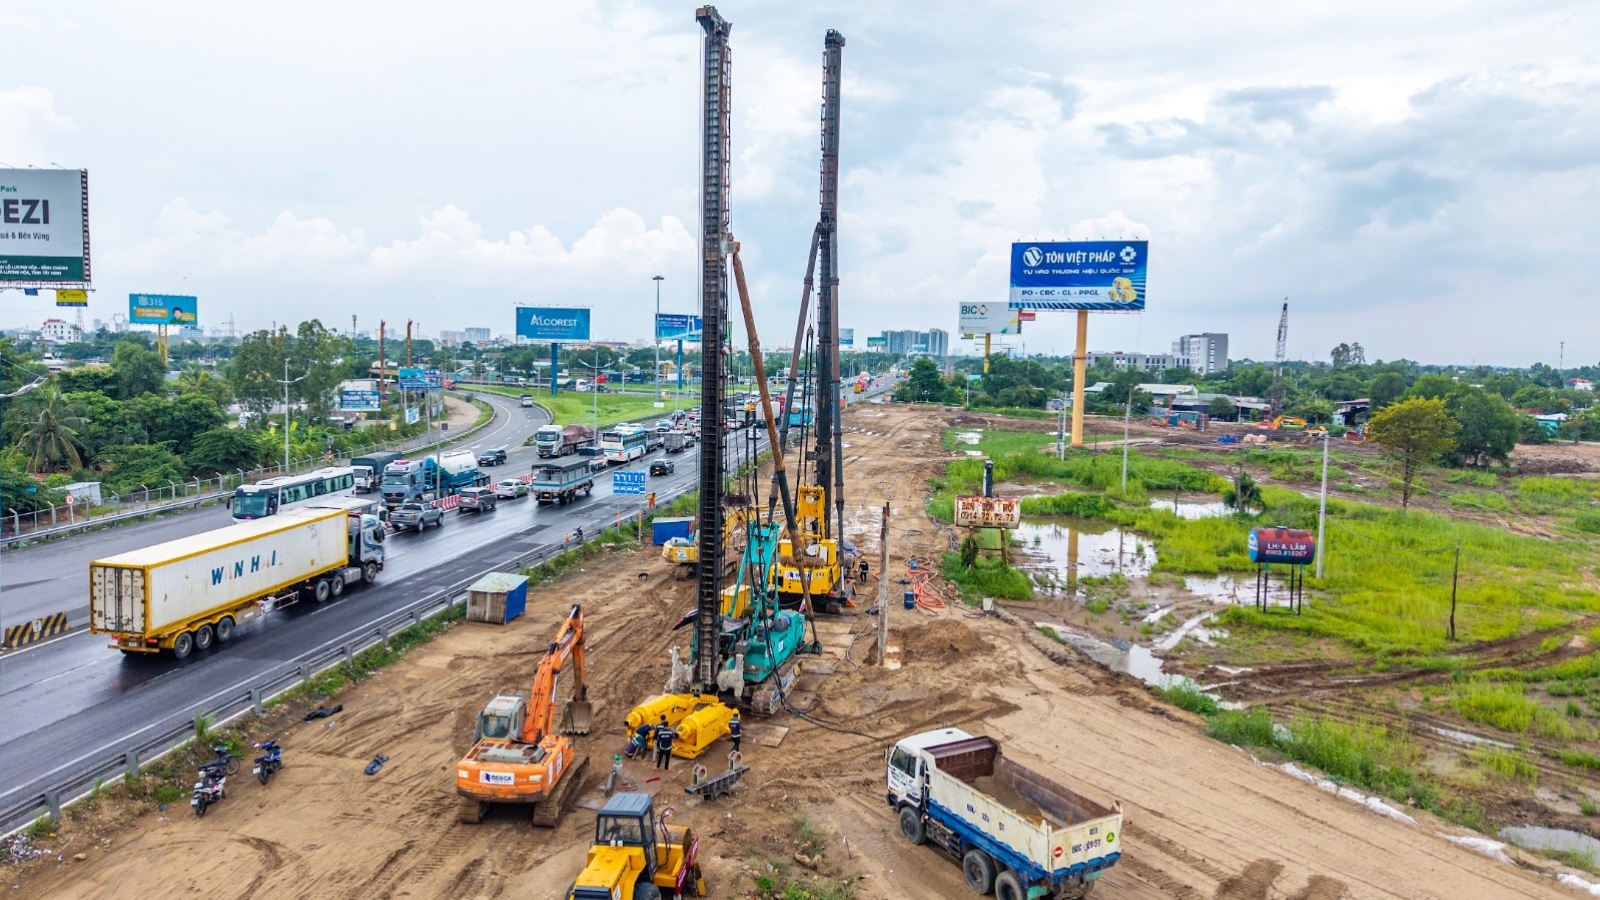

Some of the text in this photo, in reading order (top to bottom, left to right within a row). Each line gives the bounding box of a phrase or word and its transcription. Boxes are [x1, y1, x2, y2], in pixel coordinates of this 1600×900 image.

[0, 199, 49, 224] EZI
[0, 231, 9, 239] uả
[1045, 250, 1116, 265] TÔN VIỆT PHÁP
[149, 297, 164, 306] 315
[530, 314, 578, 326] ALCOREST
